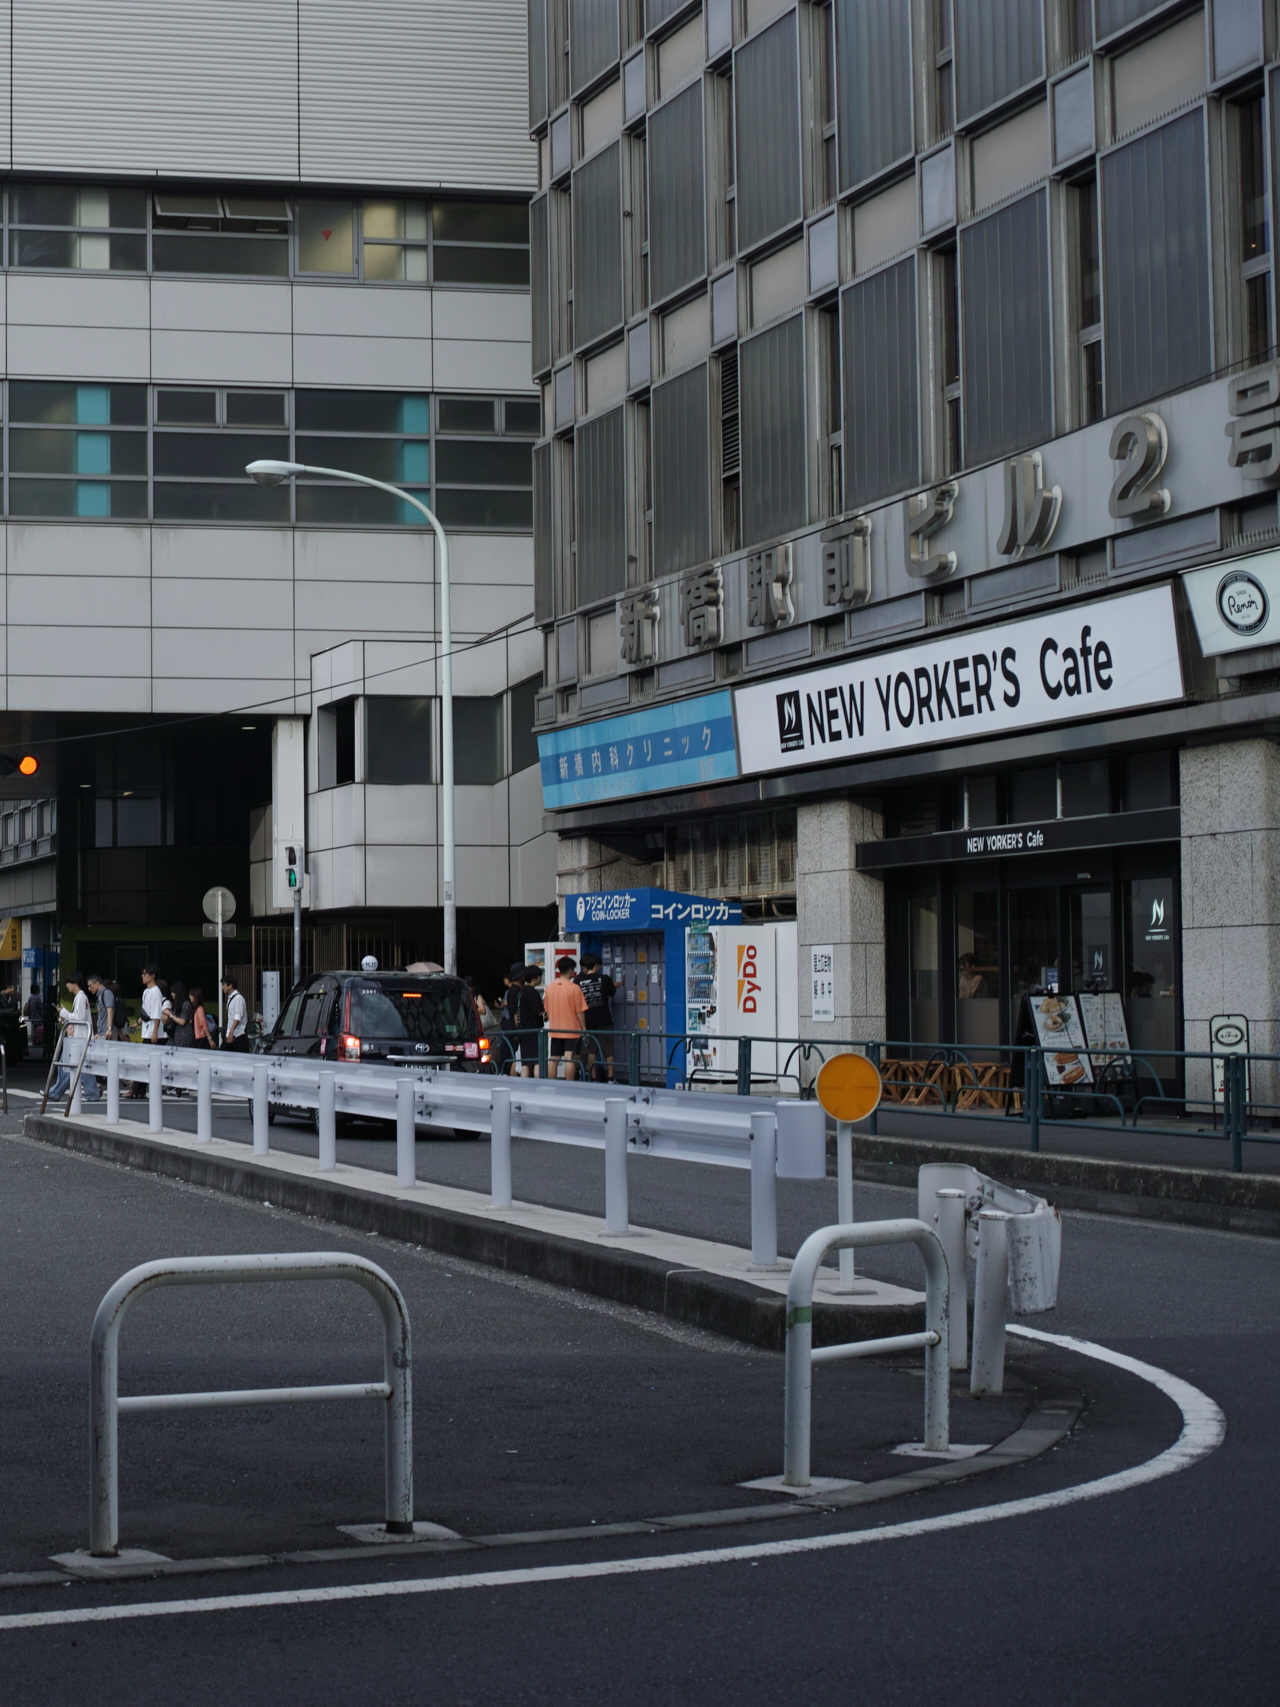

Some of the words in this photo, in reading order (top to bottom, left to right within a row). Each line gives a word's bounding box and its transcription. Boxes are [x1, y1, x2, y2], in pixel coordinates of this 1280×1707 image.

[807, 679, 865, 746] NEW
[875, 646, 1021, 729] YORKER'S
[1038, 624, 1114, 701] Cafe
[559, 725, 712, 781] 新橋内科クリニック
[967, 837, 983, 853] NEW
[986, 832, 1023, 852] YORKER'S
[1027, 830, 1044, 848] Cafe
[585, 892, 637, 911] フジコインロッカー
[651, 902, 742, 921] コインロッカー
[591, 908, 630, 922] COIN-LOCKER
[742, 944, 762, 1014] DyDo
